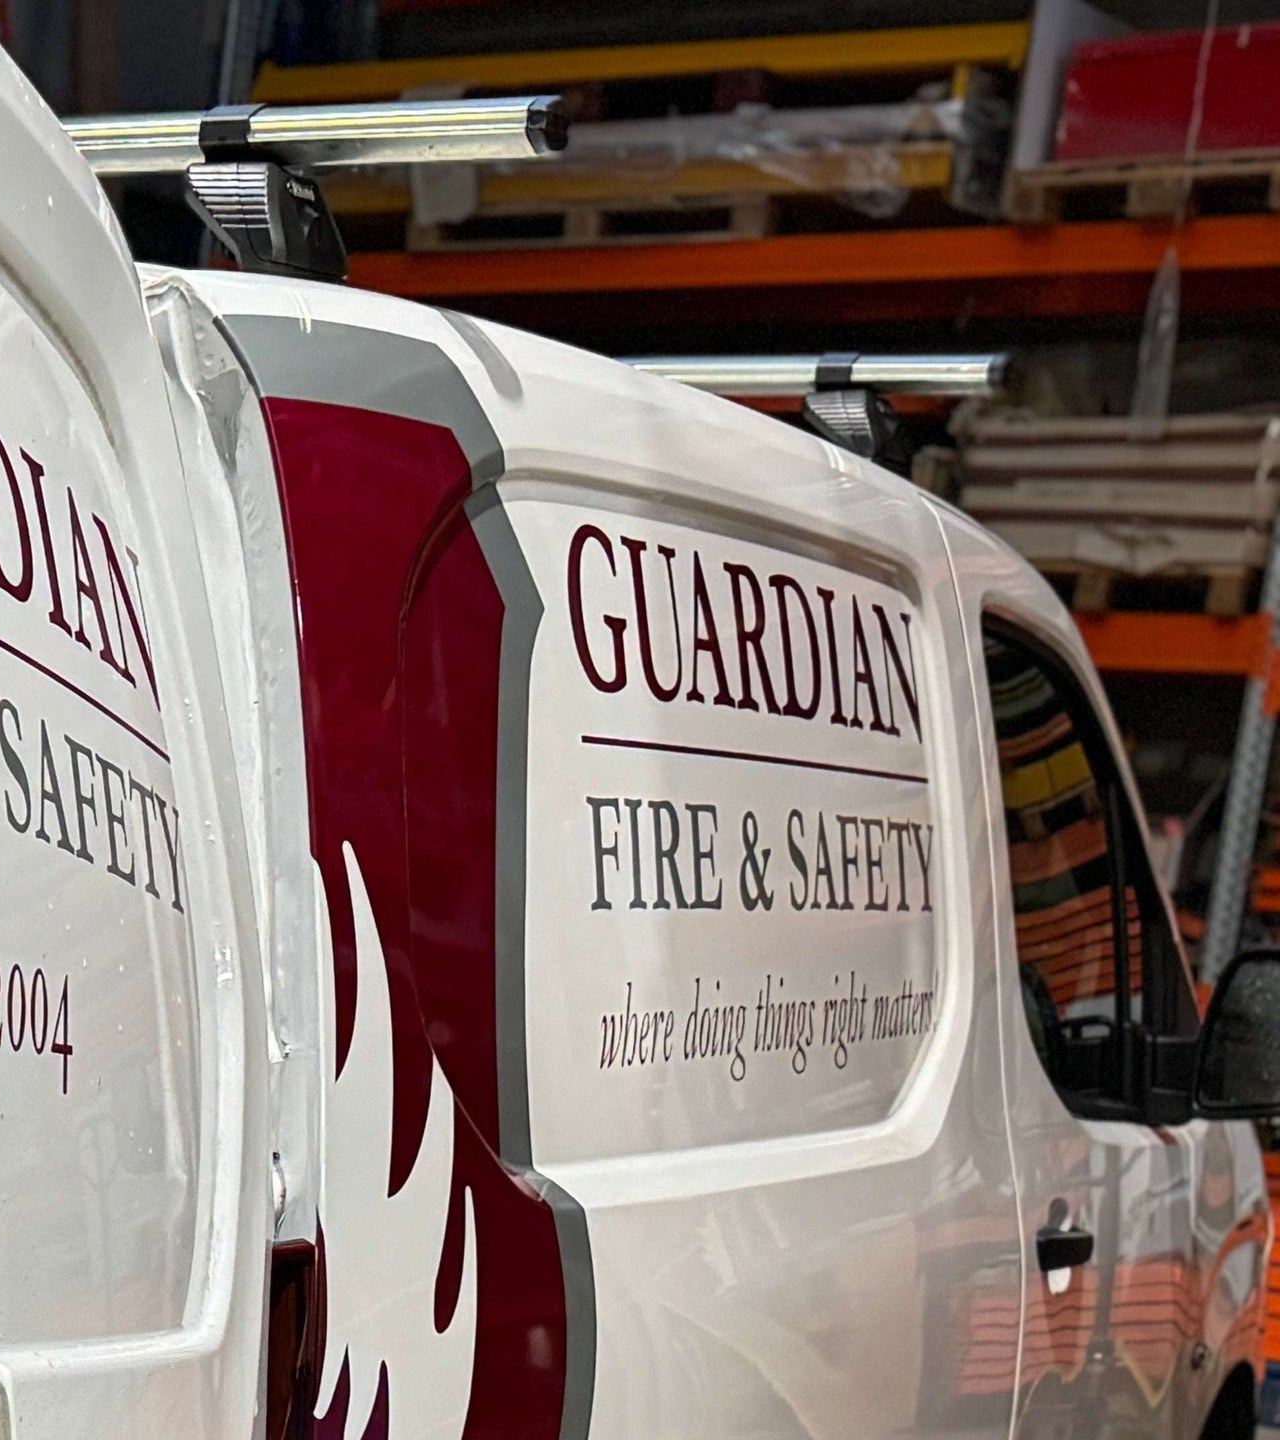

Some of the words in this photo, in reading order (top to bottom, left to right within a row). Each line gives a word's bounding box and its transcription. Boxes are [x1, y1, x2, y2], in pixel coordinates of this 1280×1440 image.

[568, 524, 922, 744] GUARDIAN
[587, 796, 722, 911] FIRE
[739, 811, 774, 911] &
[787, 809, 934, 912] SAFETY
[601, 982, 674, 1069] where
[684, 978, 746, 1081] doing
[754, 975, 816, 1074] things
[822, 972, 867, 1068] right
